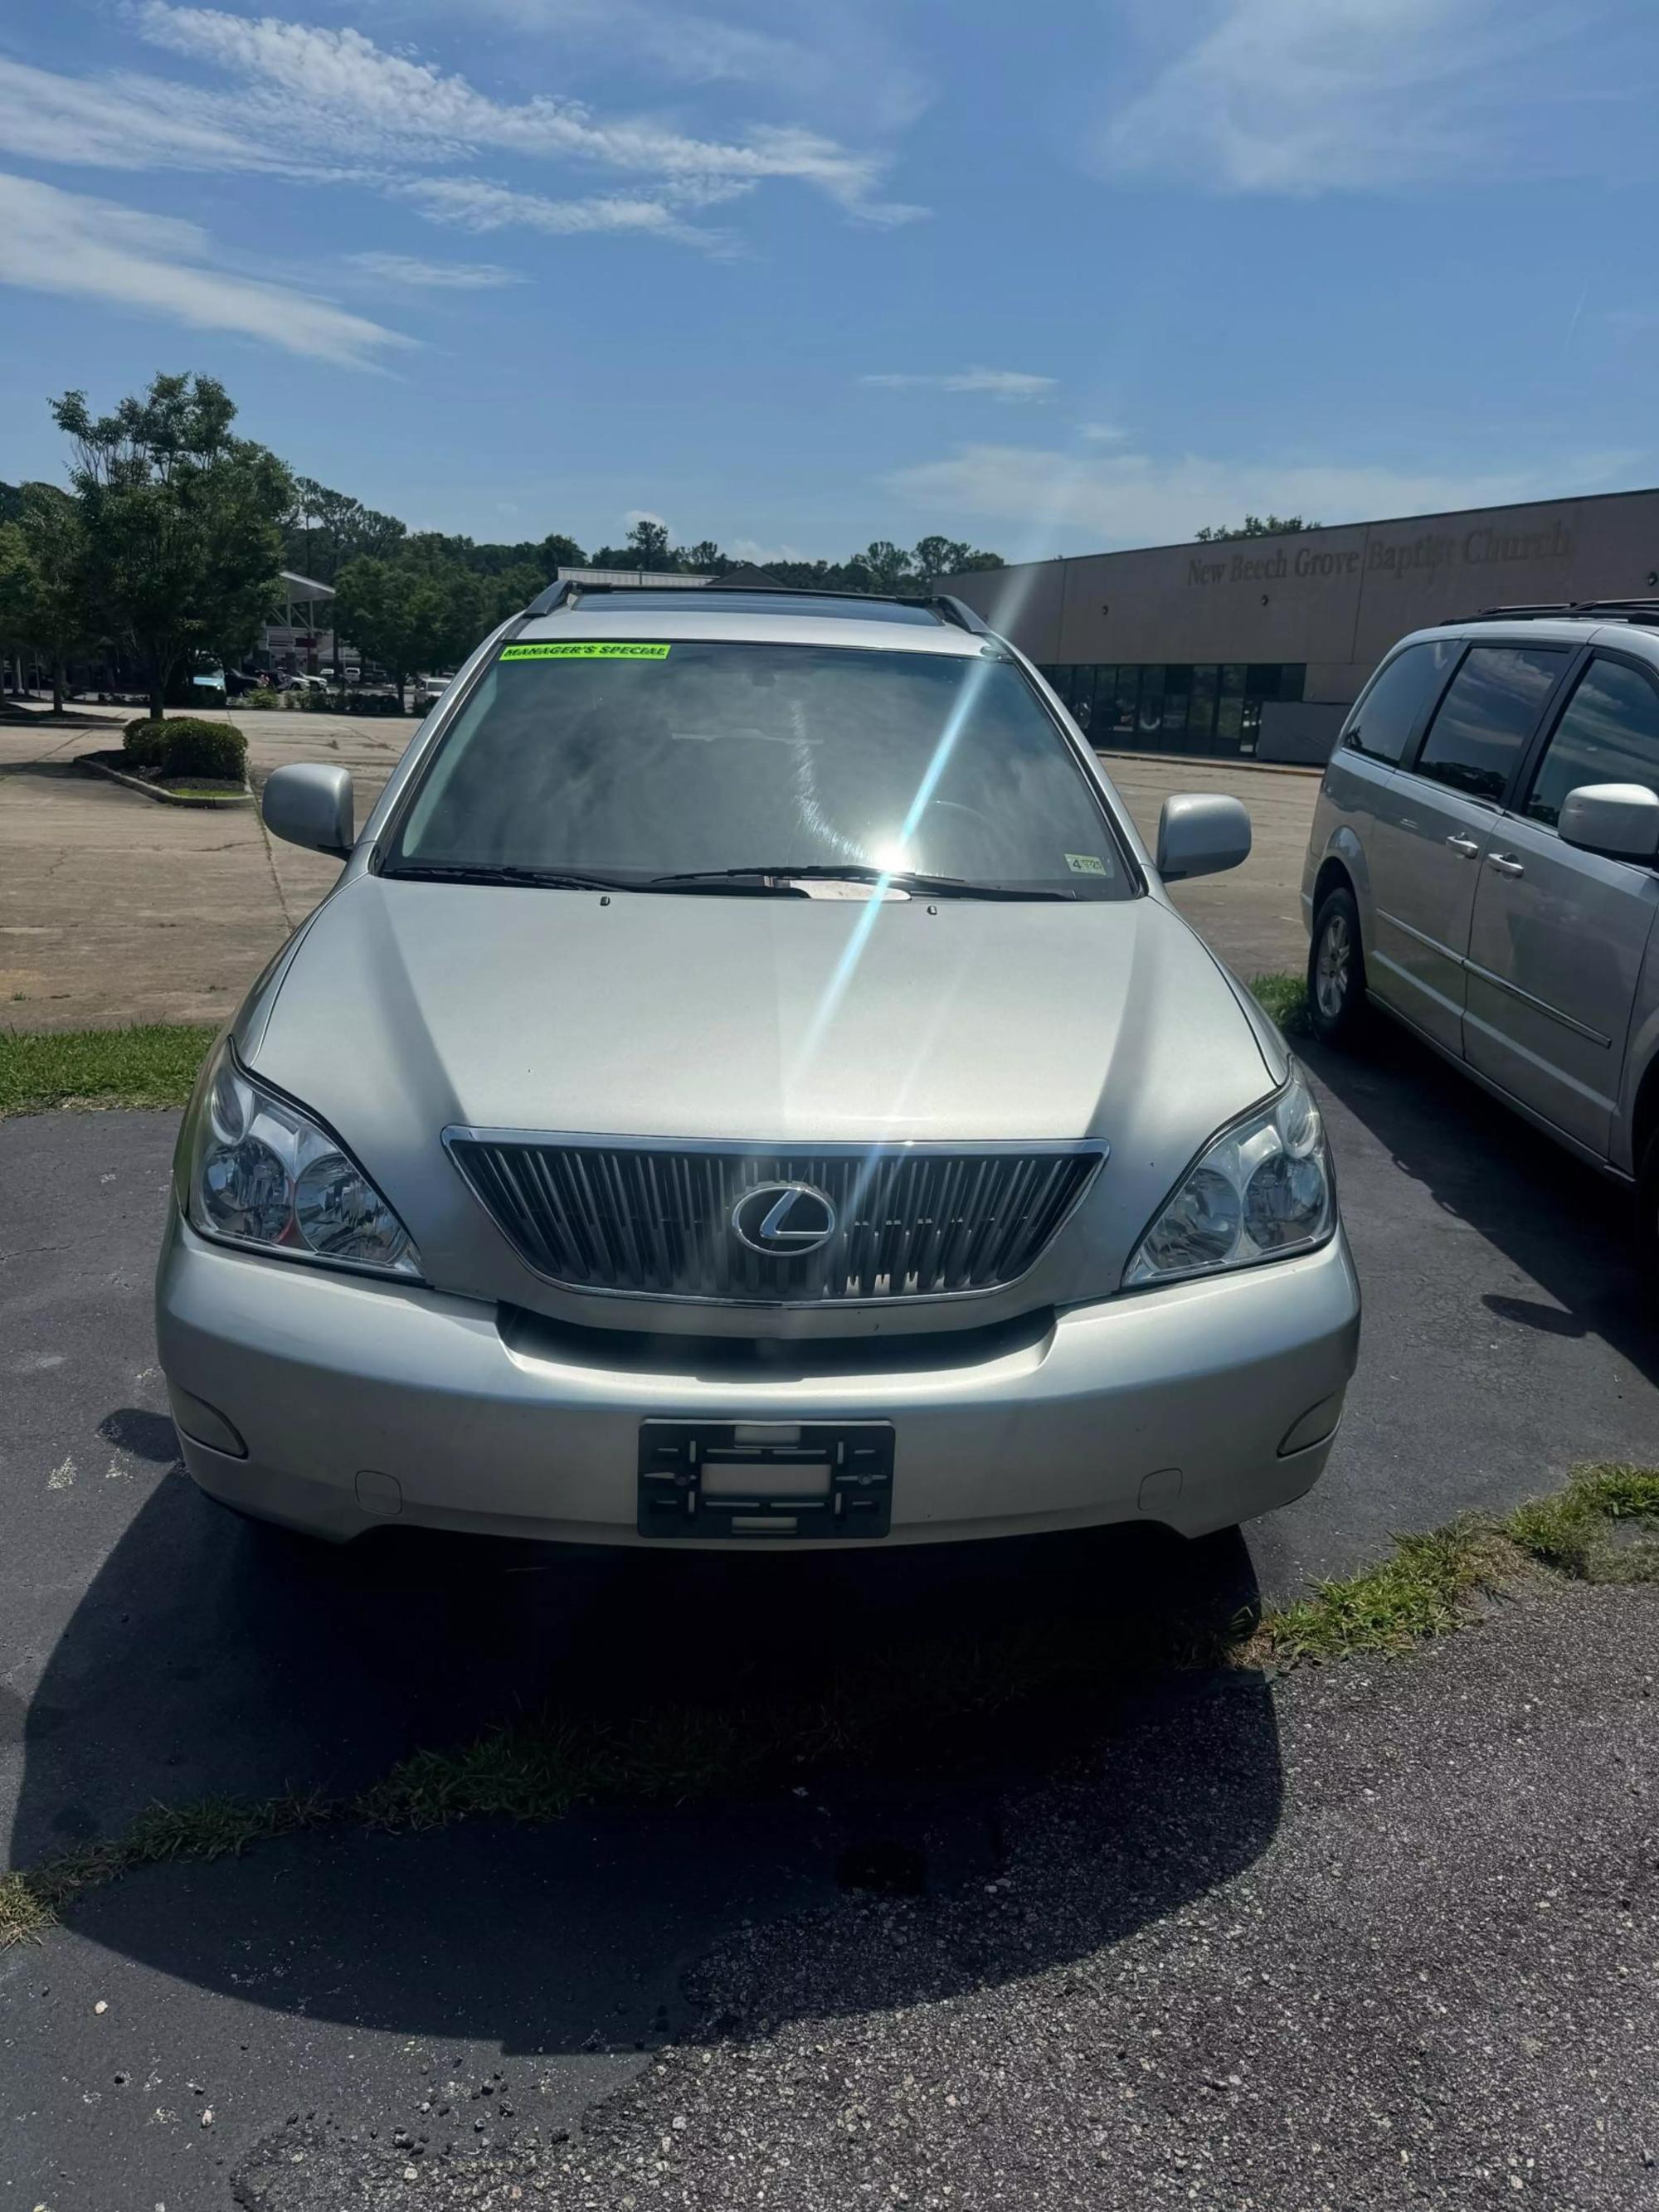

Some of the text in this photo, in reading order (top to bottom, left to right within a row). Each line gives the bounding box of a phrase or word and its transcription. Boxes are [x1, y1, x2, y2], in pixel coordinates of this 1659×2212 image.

[1188, 519, 1572, 586] New Beech Grove Baptist Church
[504, 645, 665, 656] MANAGER'S SPECIAL
